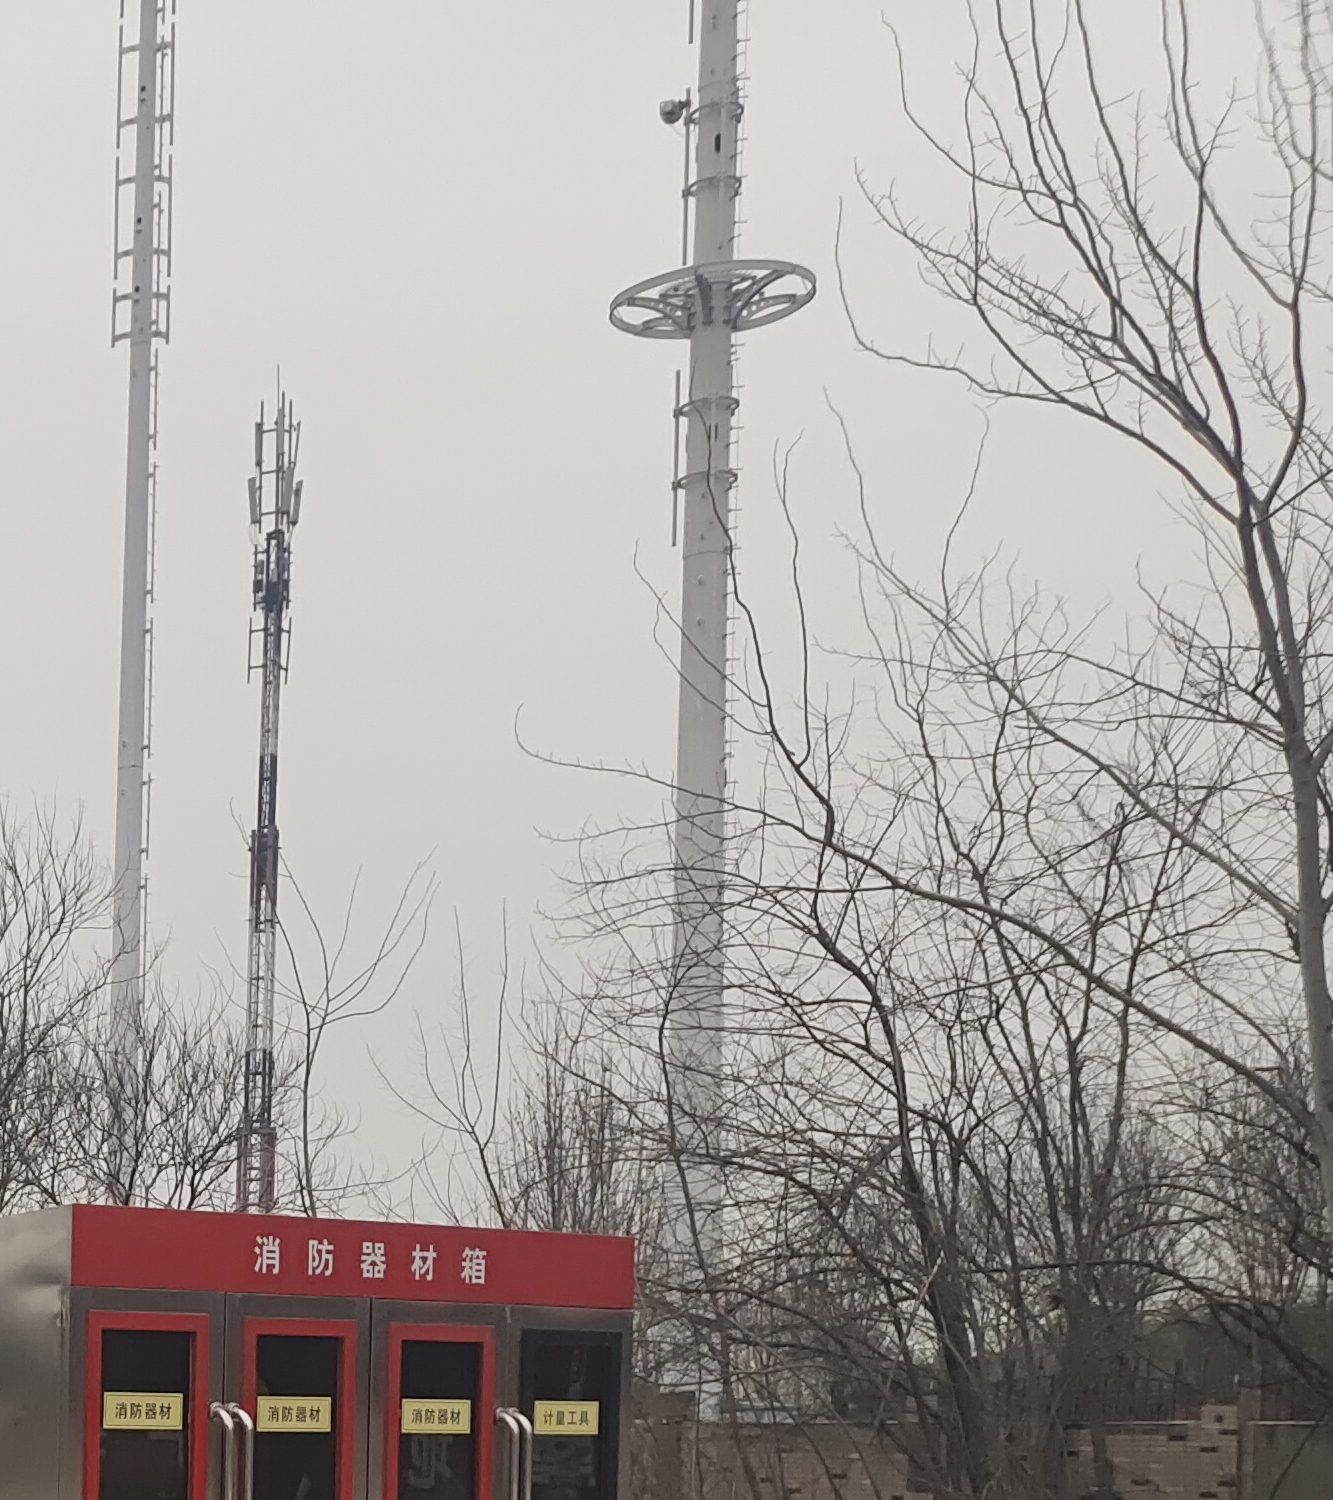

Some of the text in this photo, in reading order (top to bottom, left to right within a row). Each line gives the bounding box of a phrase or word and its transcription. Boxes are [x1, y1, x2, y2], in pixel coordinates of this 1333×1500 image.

[253, 1235, 488, 1285] 消防器材箱
[114, 1402, 173, 1421] 消防器材
[266, 1405, 322, 1424] 消防器材
[411, 1407, 462, 1426] 消防器材
[542, 1410, 591, 1427] 计量工具
